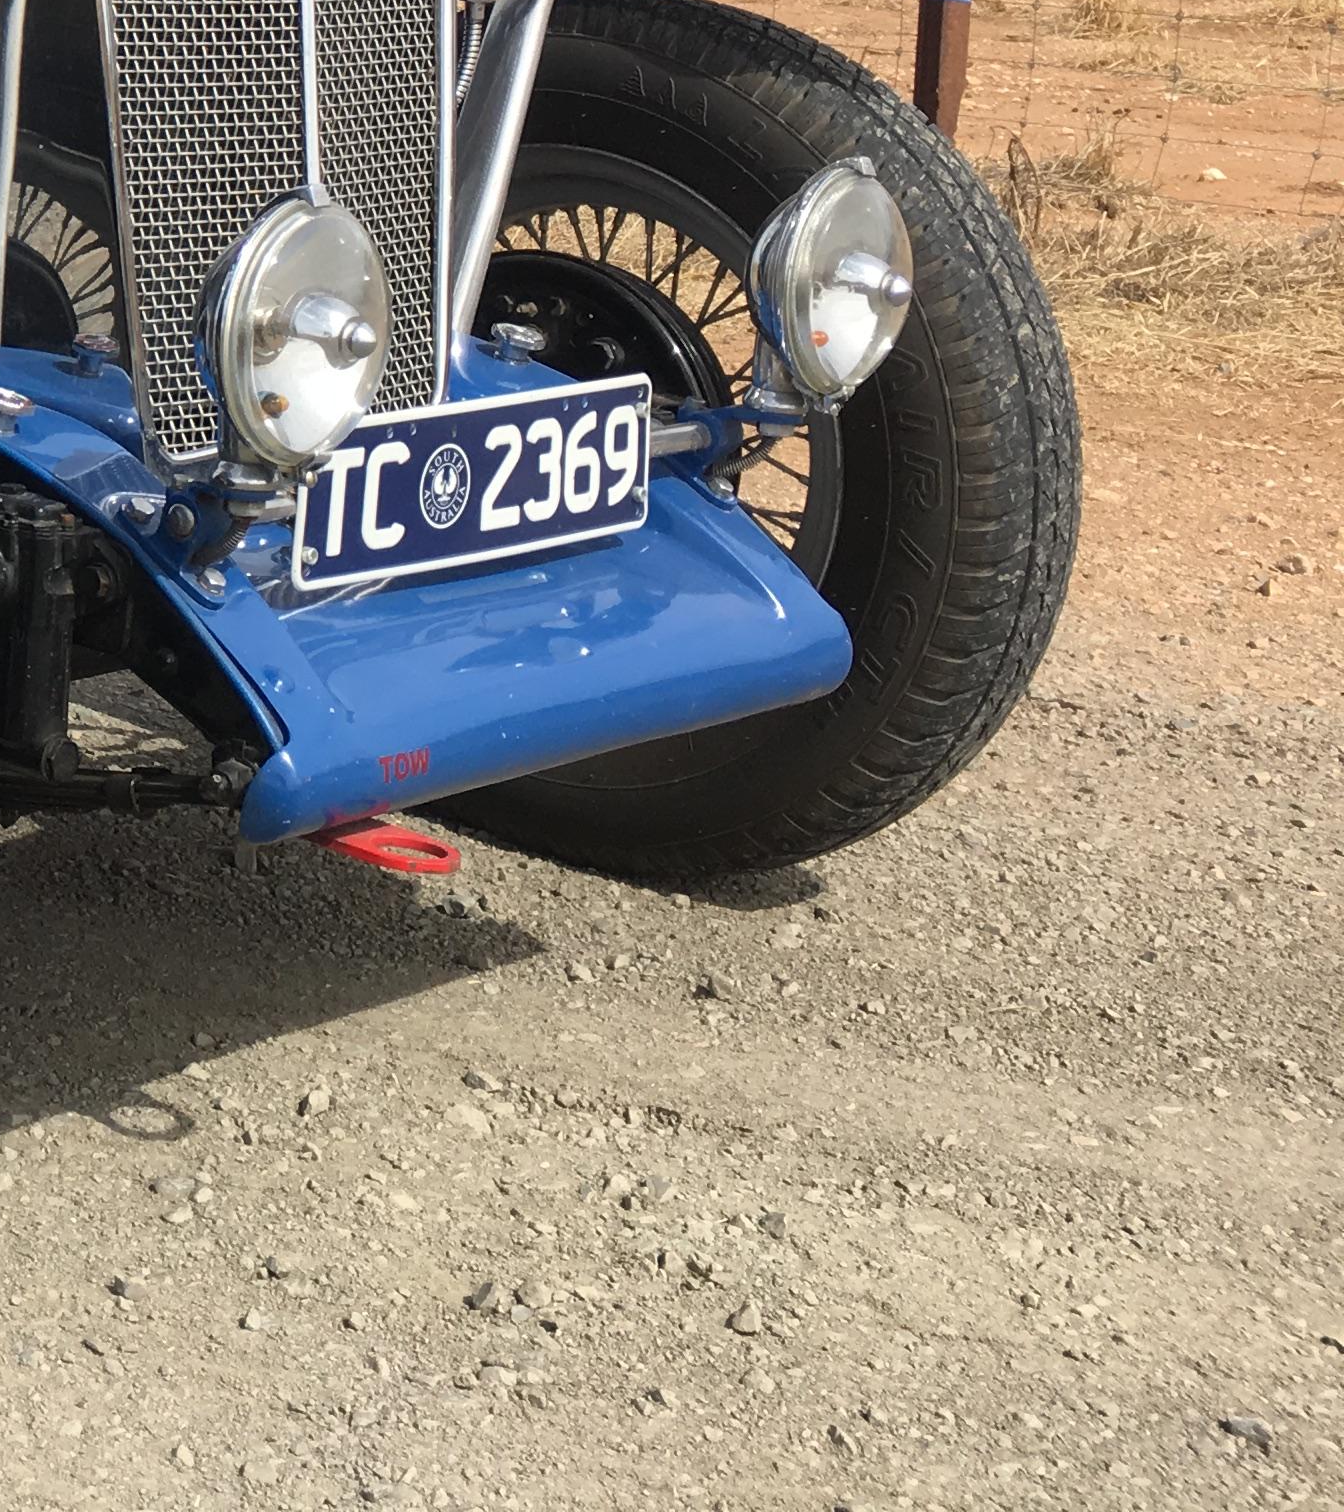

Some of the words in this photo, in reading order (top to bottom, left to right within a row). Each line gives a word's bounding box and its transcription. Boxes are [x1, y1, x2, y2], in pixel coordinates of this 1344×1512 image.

[318, 441, 410, 557] TC
[480, 404, 639, 531] 2369
[429, 451, 464, 476] SOUTH
[424, 487, 466, 522] AUSTRALIA
[378, 744, 430, 784] TOW
